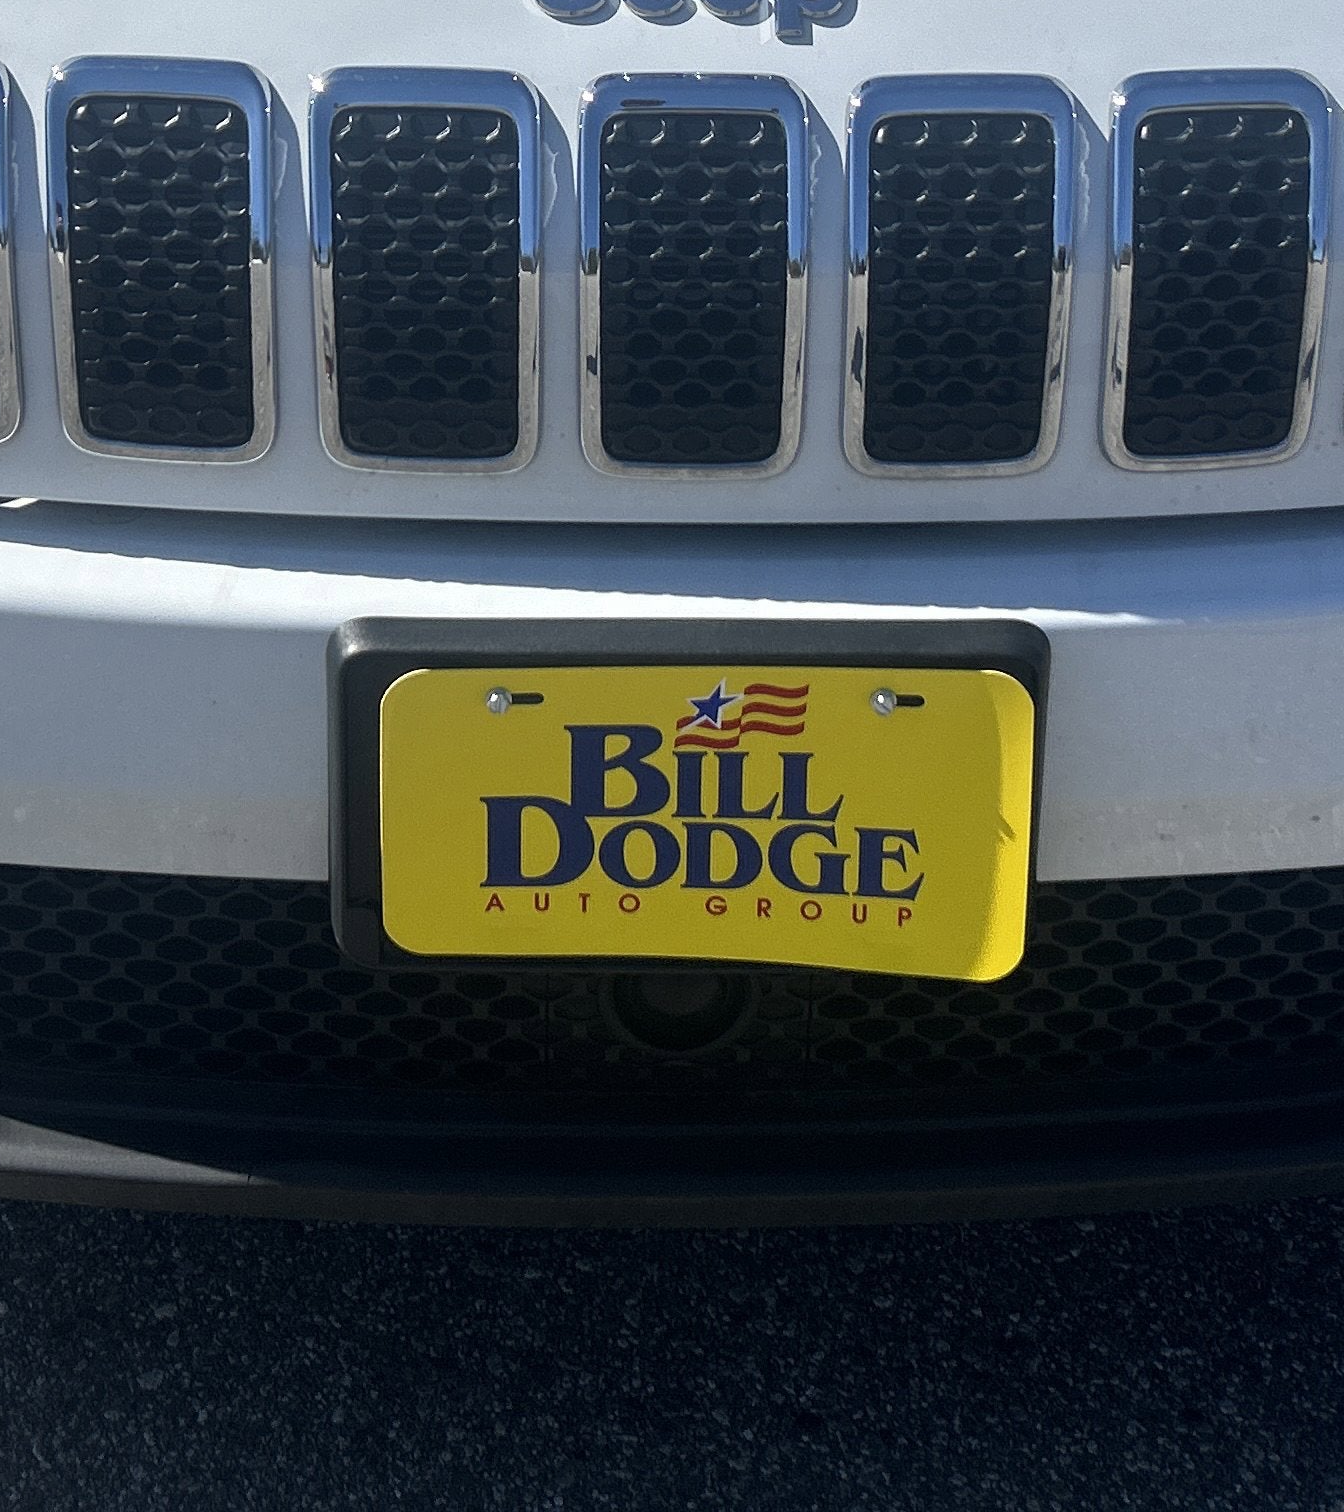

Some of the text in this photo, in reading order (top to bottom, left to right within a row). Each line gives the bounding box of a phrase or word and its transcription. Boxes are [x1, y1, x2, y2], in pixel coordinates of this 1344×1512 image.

[564, 724, 844, 823] BILL
[479, 796, 925, 902] DODGE
[484, 891, 915, 927] AUTO GROUP
